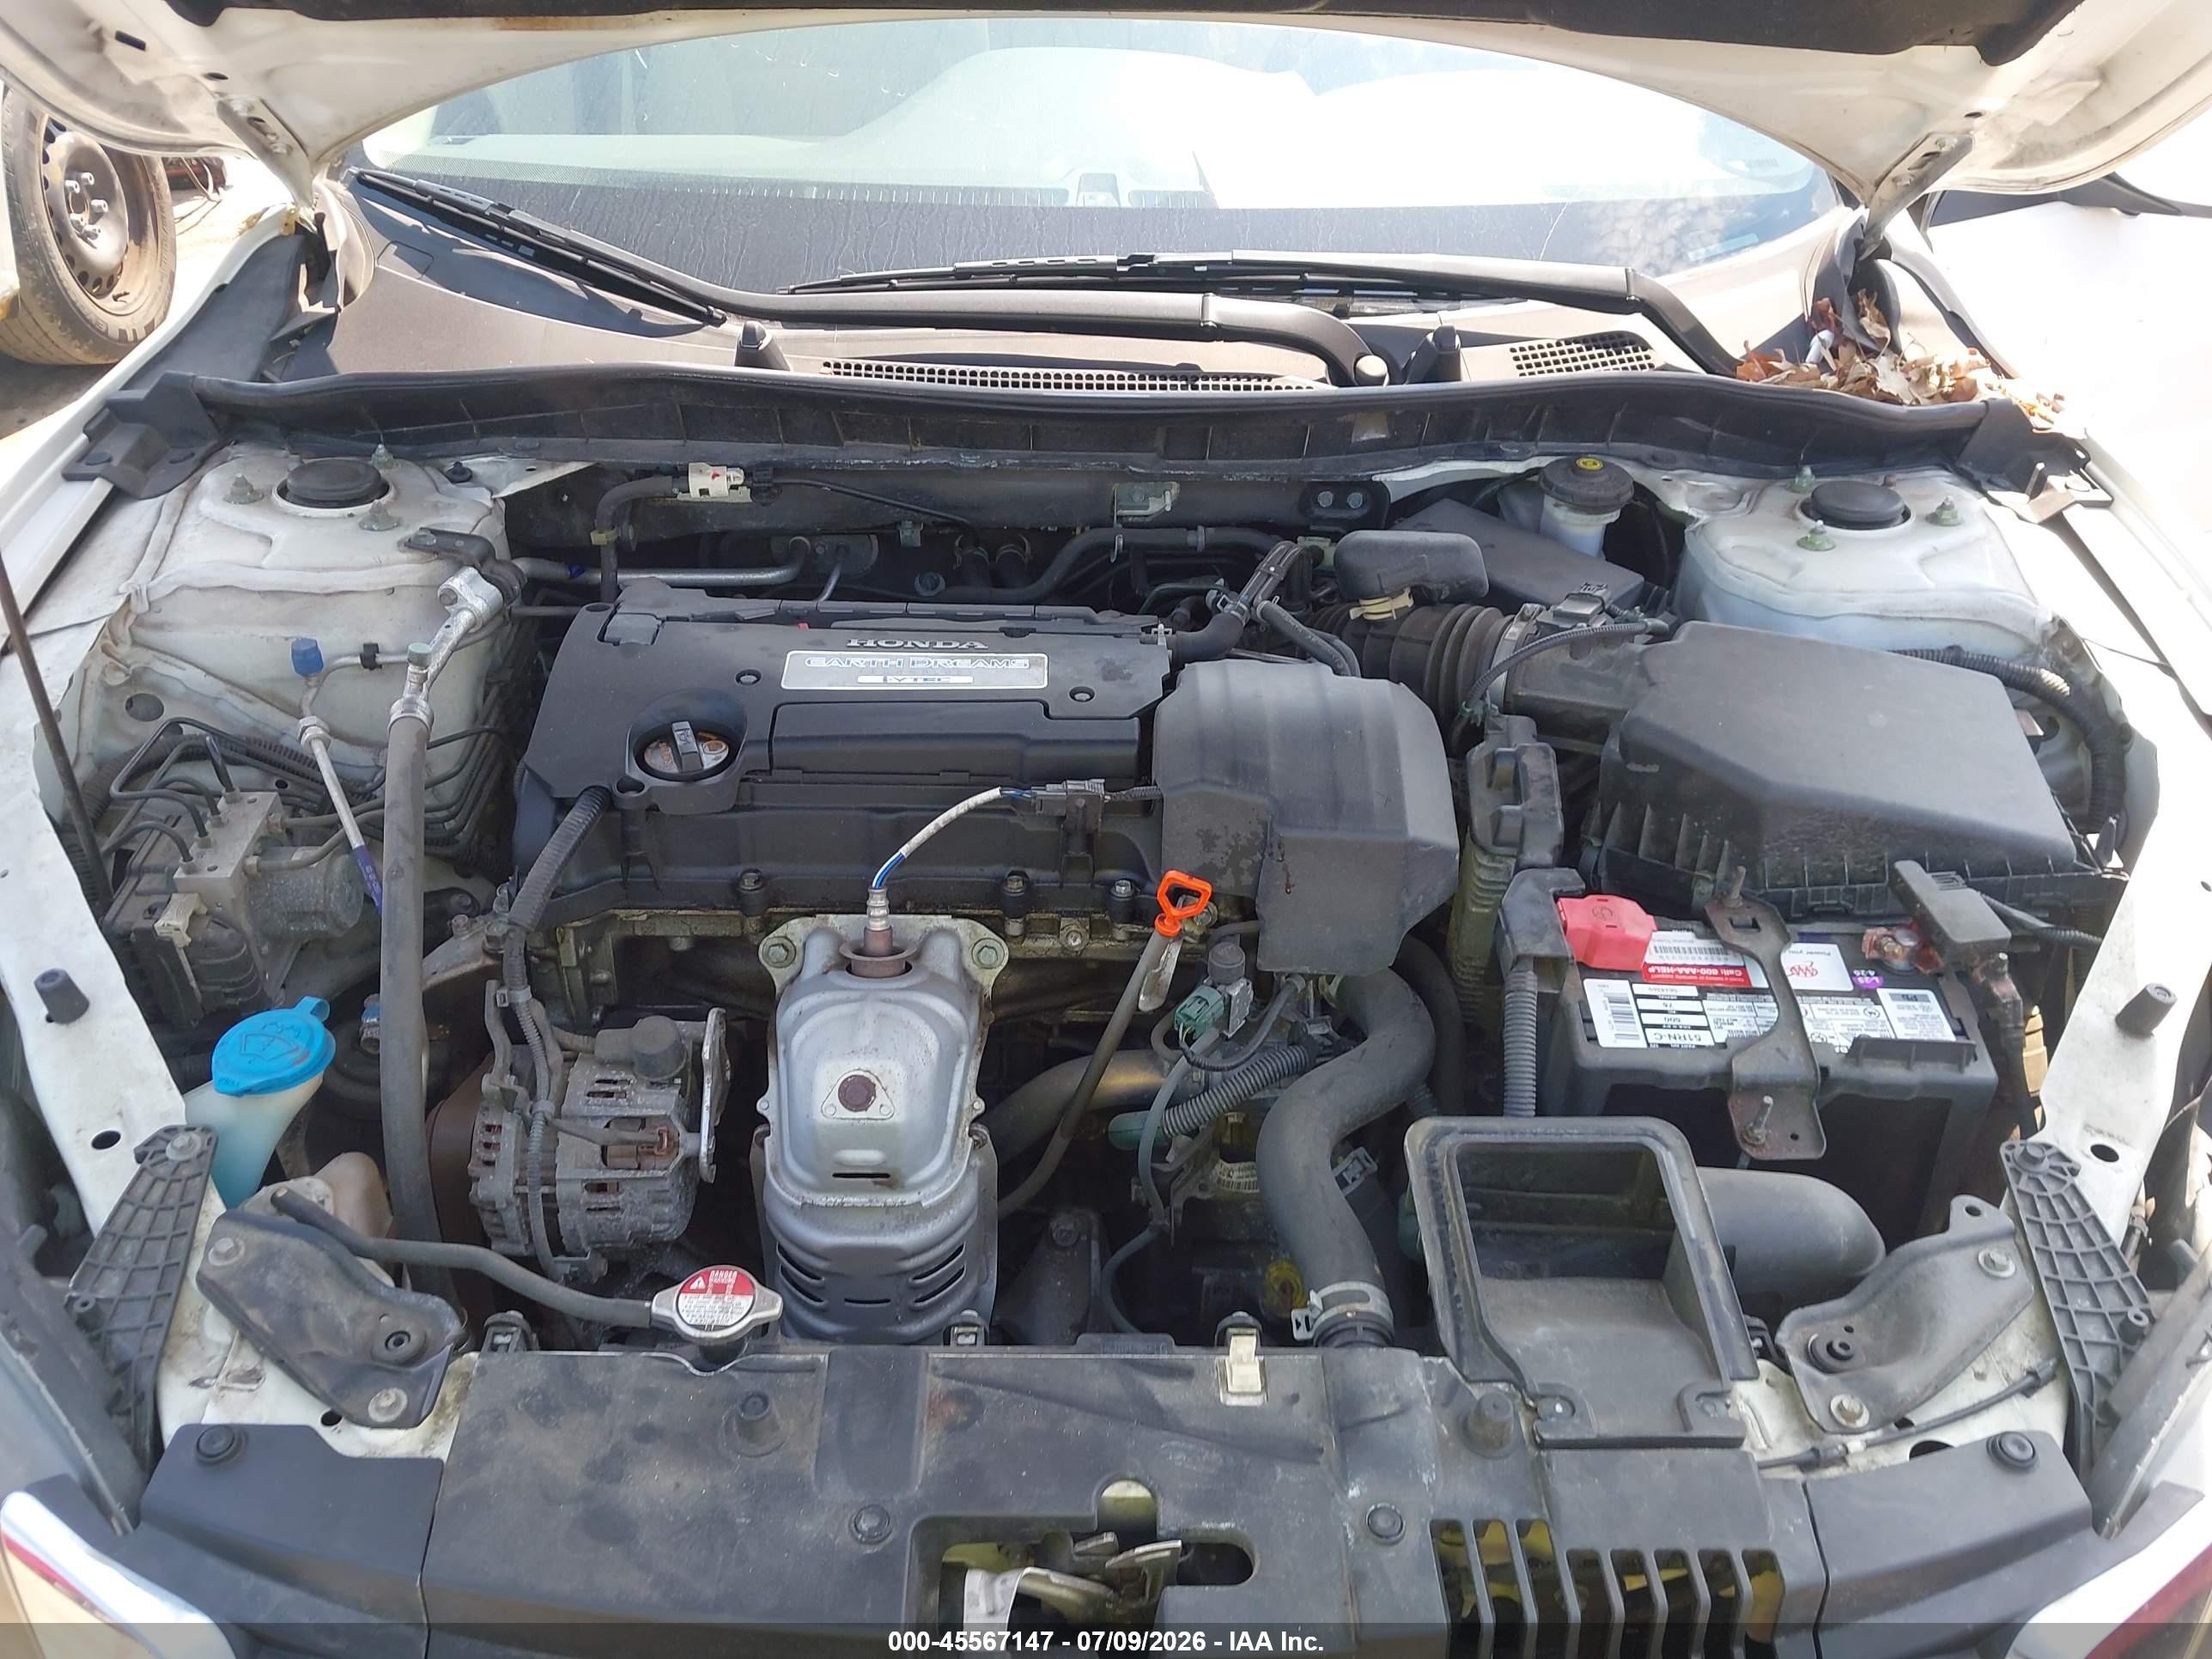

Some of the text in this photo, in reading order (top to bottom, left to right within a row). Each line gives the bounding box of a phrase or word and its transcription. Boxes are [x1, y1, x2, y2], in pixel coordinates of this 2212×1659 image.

[847, 638, 988, 649] HONDA
[805, 656, 1030, 669] EARTH DREAMS
